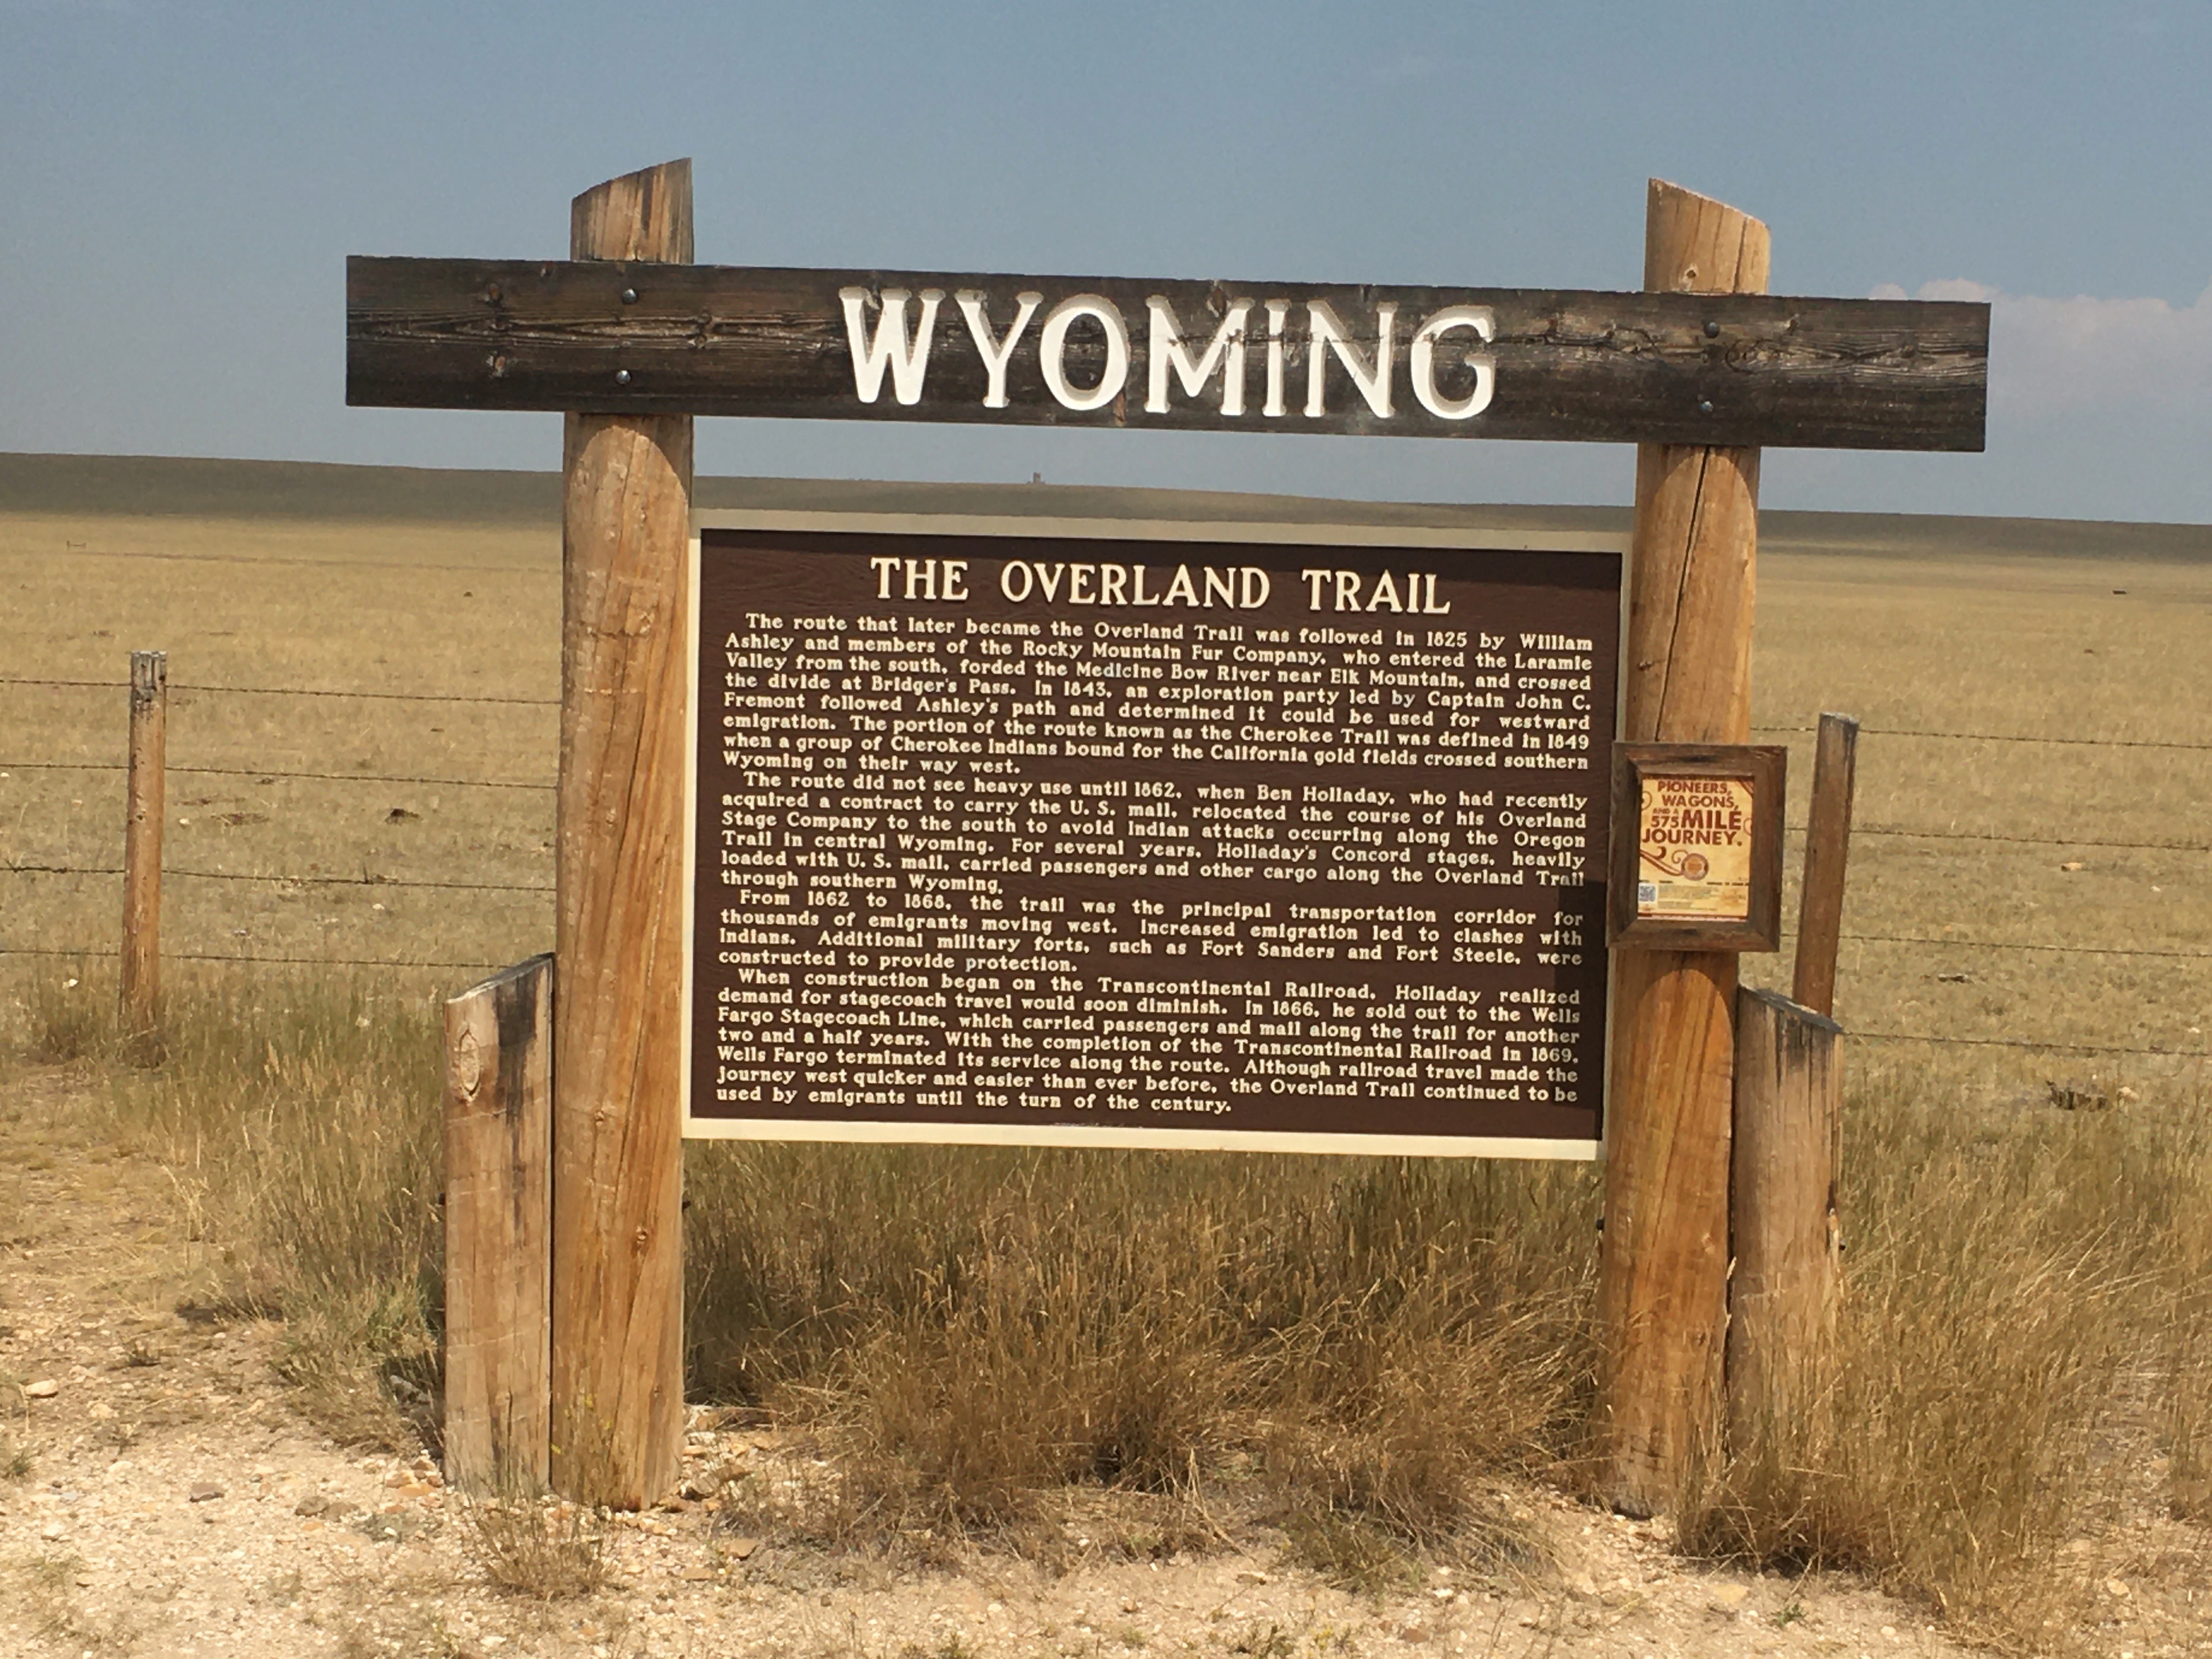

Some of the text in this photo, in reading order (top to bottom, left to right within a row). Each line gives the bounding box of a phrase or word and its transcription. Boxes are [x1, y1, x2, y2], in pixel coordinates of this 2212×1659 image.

[839, 286, 1495, 419] WYOMING
[871, 557, 1450, 613] THE OVERLAND TRAIL
[746, 613, 1592, 651] The route that later became the Overland Trail was followed in 1825 by William
[726, 652, 787, 670] Valley
[796, 654, 843, 670] from
[849, 656, 881, 671] the
[960, 659, 1025, 675] forded
[1035, 661, 1067, 676] the
[1077, 662, 1163, 679] Medicine
[1171, 664, 1208, 679] Bow
[1217, 665, 1269, 681] River
[1278, 671, 1321, 683] near
[1331, 668, 1359, 684] Elk
[1476, 673, 1510, 688] and
[1518, 675, 1590, 690] crossed
[724, 692, 1589, 729] Fremont followed Ashley's path and determined it could be used for westward
[724, 732, 1588, 769] when a group of Cherokee Indians bound for the California gold fields crossed southern
[1657, 781, 1732, 795] PIONEERS,
[1662, 794, 1739, 810] WAGONS,
[722, 811, 1585, 850] Stage Company to the south to avoid Indian attacks occurring along the Oregon
[1642, 828, 1742, 847] JOURNEY.
[1651, 809, 1742, 830] 575 MILE
[741, 889, 789, 905] From
[808, 891, 849, 906] 1862
[866, 893, 887, 907] to
[970, 895, 1003, 910] the
[1020, 897, 1064, 912] trail
[1082, 902, 1115, 913] was
[1132, 900, 1164, 915] the
[1182, 901, 1271, 921] principal
[1290, 904, 1436, 923] transportation
[1454, 909, 1536, 924] corridor
[1554, 912, 1583, 926] for
[721, 909, 1581, 945] thousands of emigrants moving west. Increased emigration led to clashes with
[719, 950, 1077, 972] constructed to provide protection.
[738, 968, 789, 984] When
[805, 971, 928, 987] construction
[941, 973, 1000, 992] began
[1013, 979, 1035, 990] on
[1051, 976, 1083, 991] the
[1097, 977, 1270, 996] Transcontinental
[1396, 985, 1481, 1004] Holladay
[1500, 988, 1579, 1004] realized
[718, 1006, 773, 1025] Fargo
[781, 1008, 890, 1028] Stagecoach
[959, 1013, 1013, 1028] which
[1023, 1015, 1094, 1030] carried
[1103, 1020, 1209, 1036] passengers
[1217, 1019, 1250, 1034] and
[1260, 1021, 1300, 1035] mail
[1310, 1022, 1361, 1041] along
[1370, 1023, 1402, 1039] the
[1413, 1024, 1456, 1040] trail
[1467, 1026, 1496, 1041] for
[1505, 1028, 1579, 1043] another
[718, 1046, 1577, 1082] Wells Fargo terminated its service along the route. Although railroad travel made the
[717, 1086, 1231, 1114] used by emigrants until the turn of the century.
